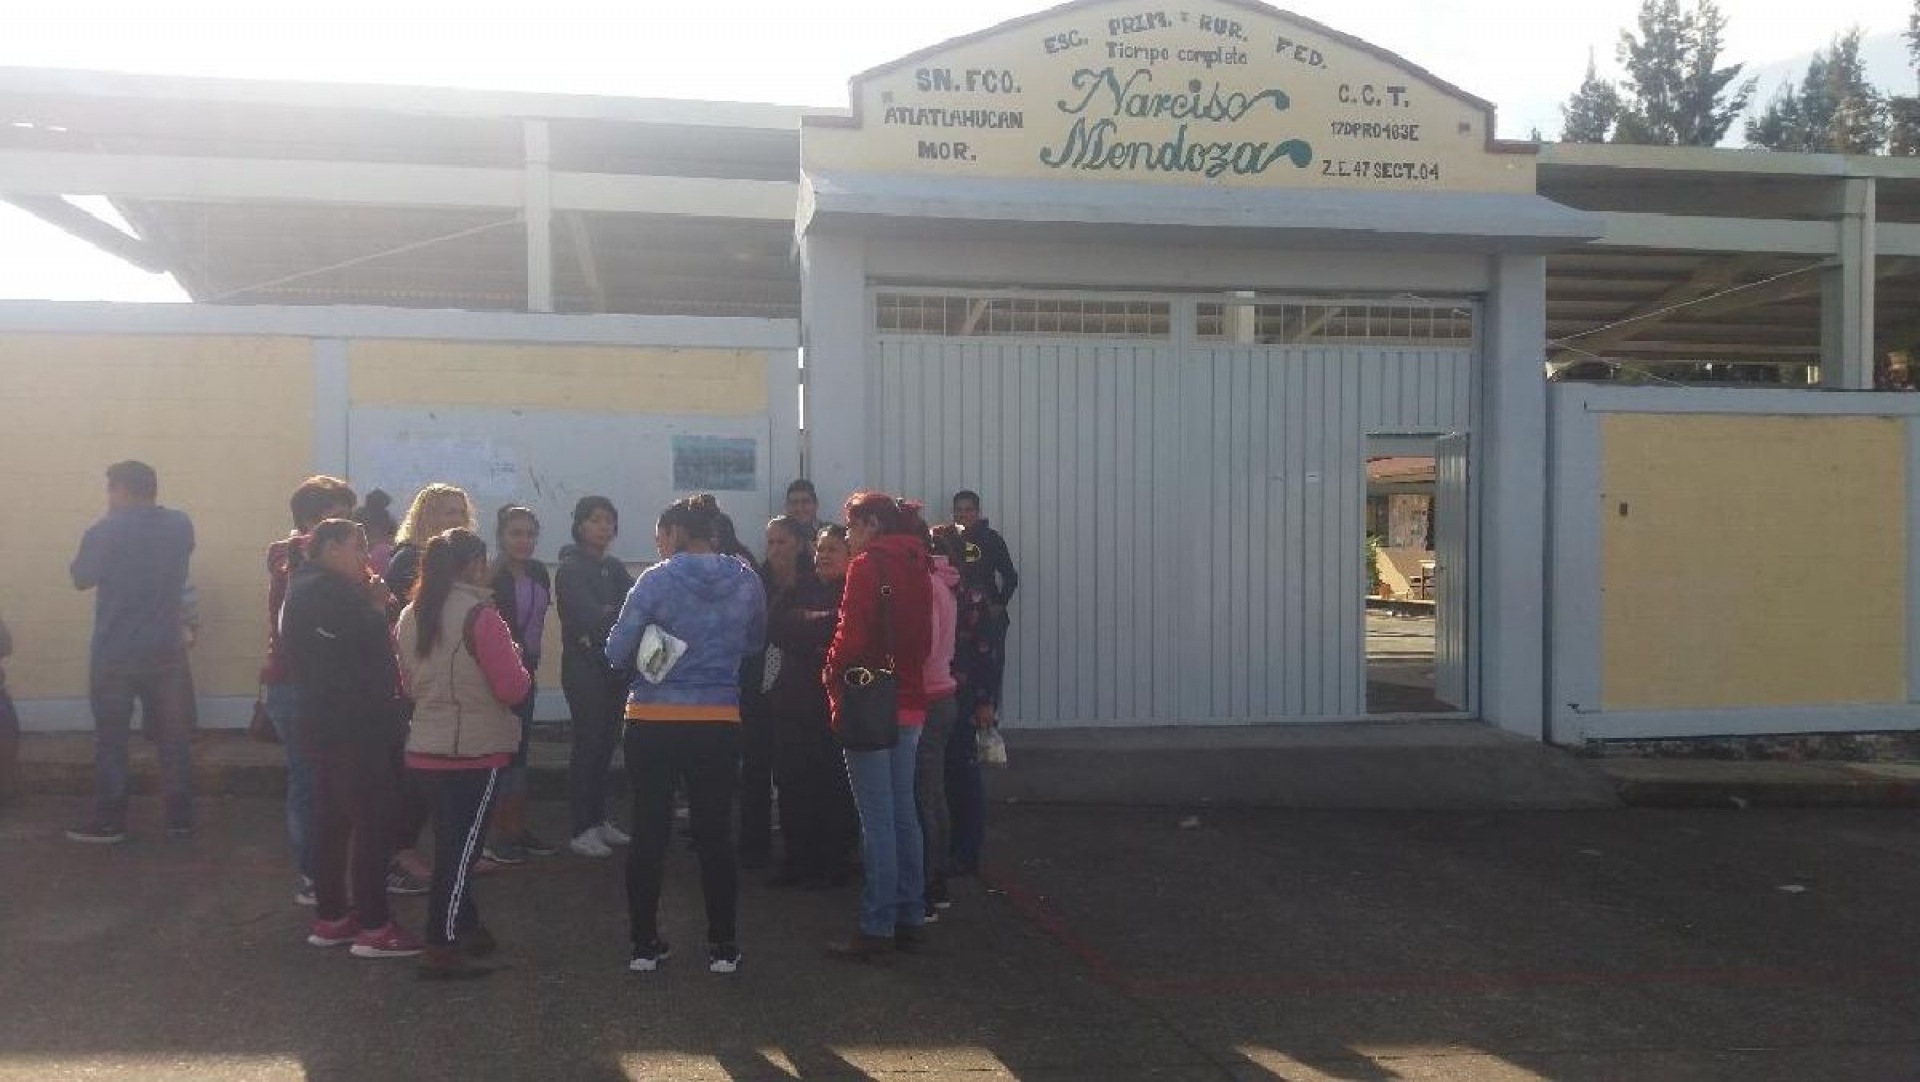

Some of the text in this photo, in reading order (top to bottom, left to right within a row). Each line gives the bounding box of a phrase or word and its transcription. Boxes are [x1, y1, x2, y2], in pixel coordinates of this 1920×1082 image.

[1044, 12, 1327, 69] ESC. PRIM. RUR. FED.
[884, 106, 1023, 129] ATLATLAHUCAN
[1057, 67, 1290, 122] Narciso
[918, 140, 977, 161] MOR.
[1039, 117, 1312, 178] Mendoza
